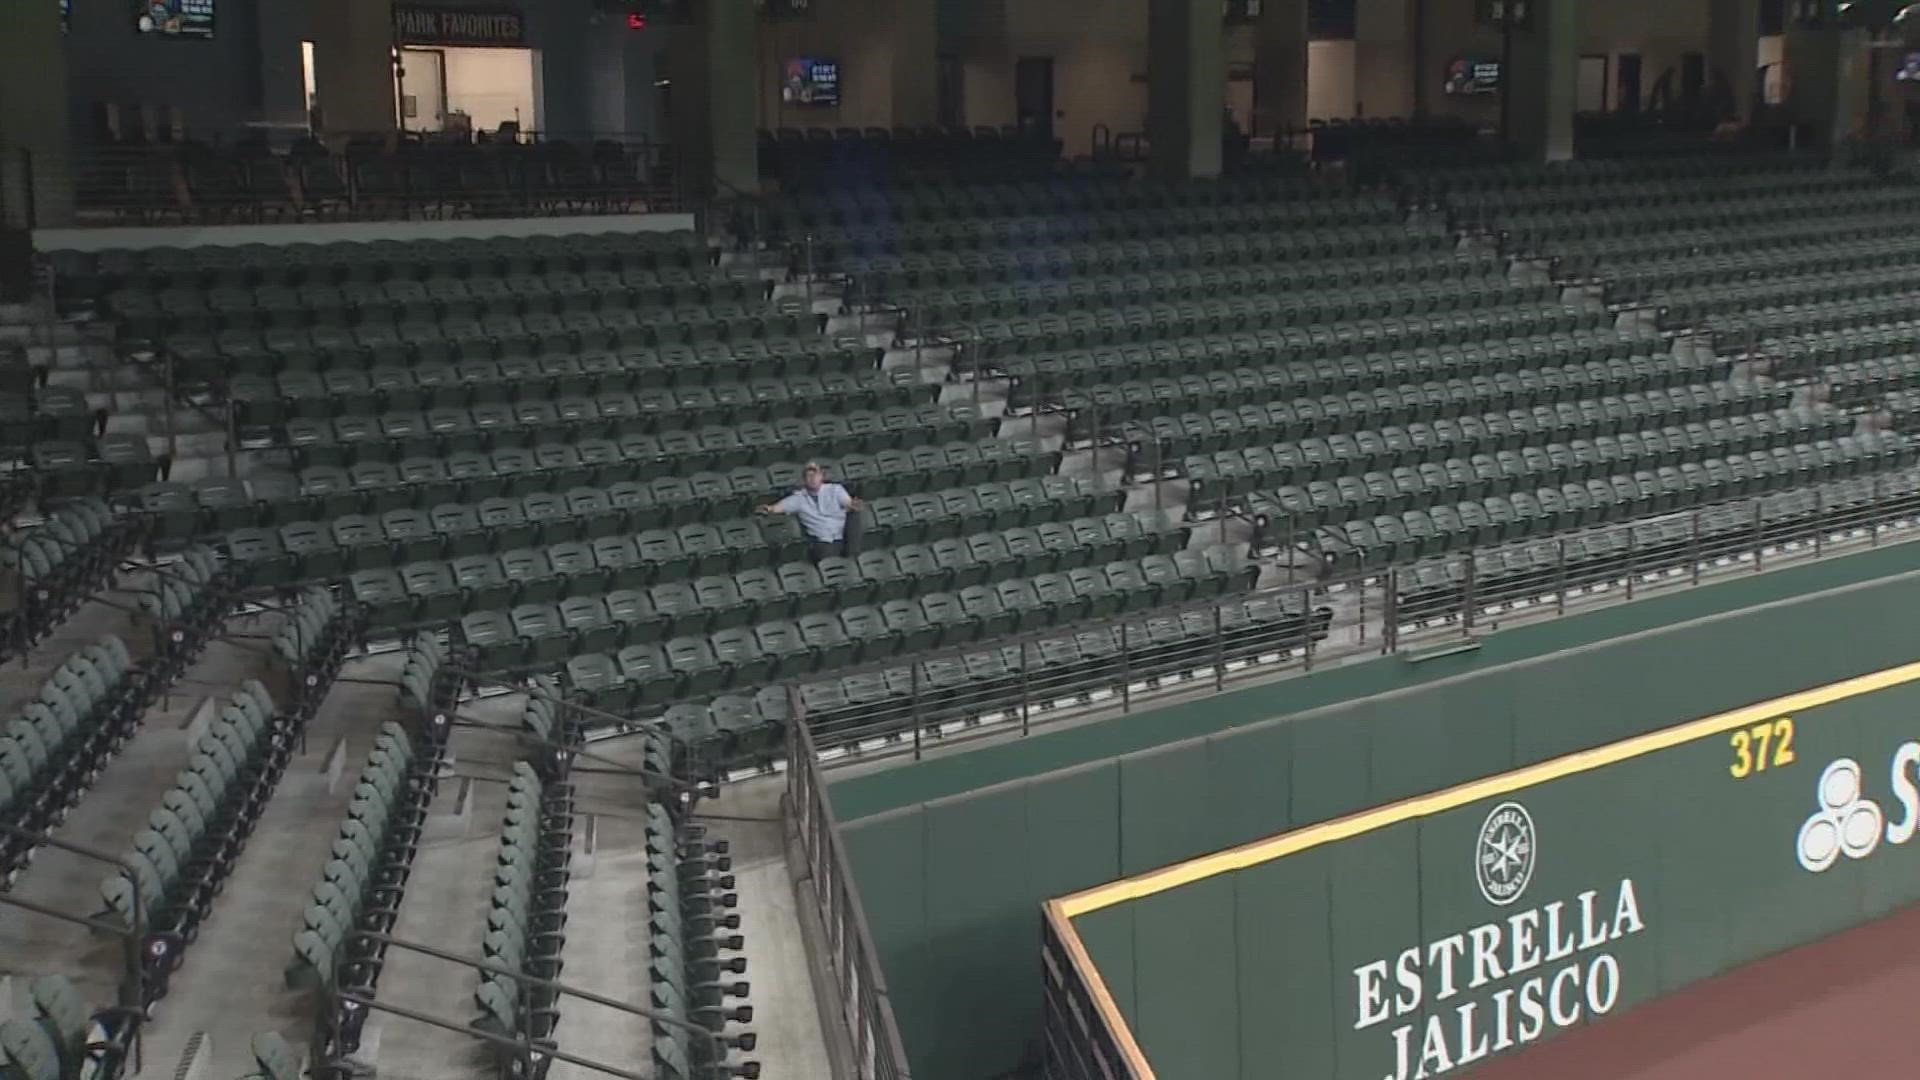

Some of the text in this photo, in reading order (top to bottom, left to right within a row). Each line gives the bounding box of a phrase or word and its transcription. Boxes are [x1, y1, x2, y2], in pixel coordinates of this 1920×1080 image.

[396, 9, 520, 38] PARK FAVORITES
[1729, 718, 1796, 778] 372
[1353, 877, 1645, 1030] ESTRELLA
[1382, 953, 1620, 1080] JALISCO
